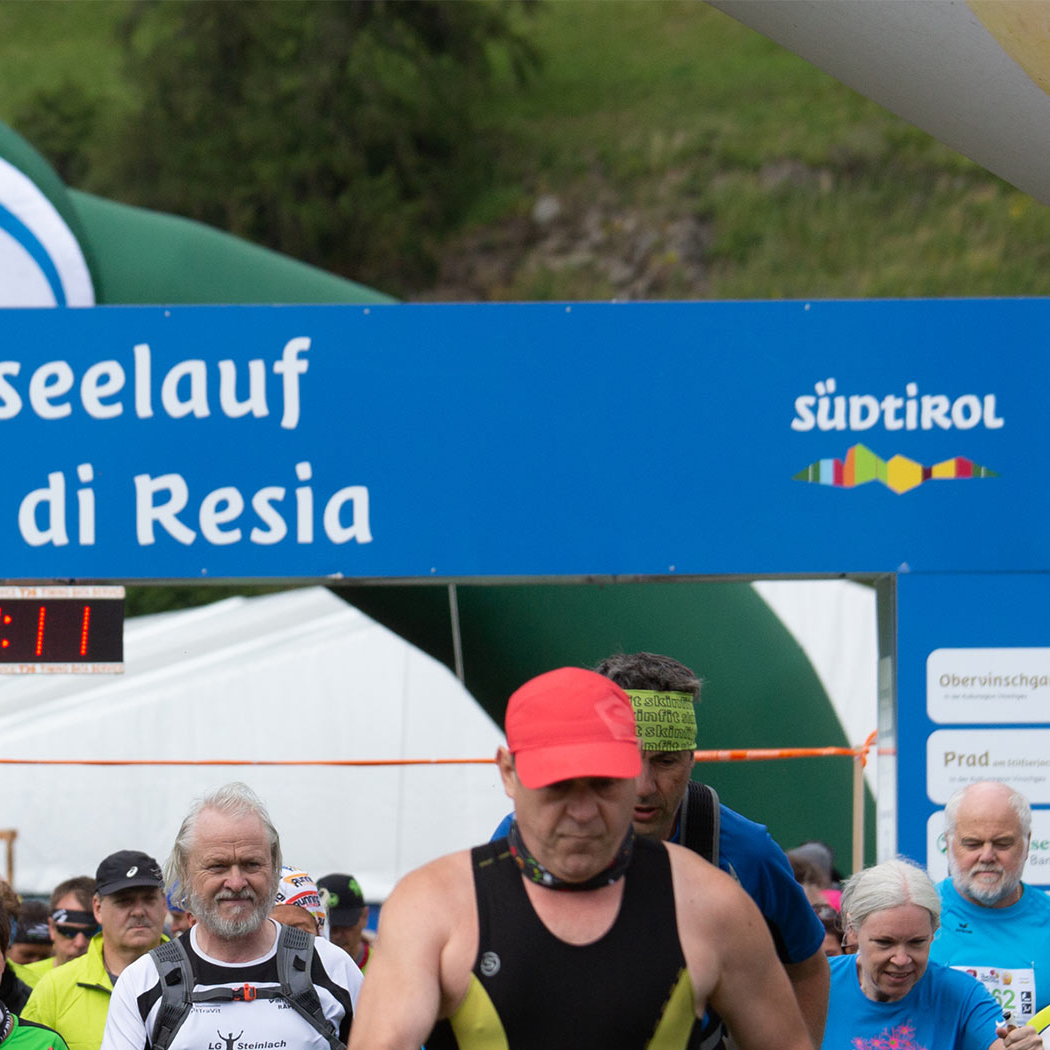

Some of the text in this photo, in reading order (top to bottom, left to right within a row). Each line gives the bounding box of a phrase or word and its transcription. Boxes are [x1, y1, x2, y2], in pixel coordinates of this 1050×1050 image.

[19, 464, 96, 547] di
[135, 462, 373, 547] Resia
[939, 672, 1050, 690] Obervinschga
[944, 751, 990, 767] Prad
[208, 1040, 287, 1050] LG Steinlach
